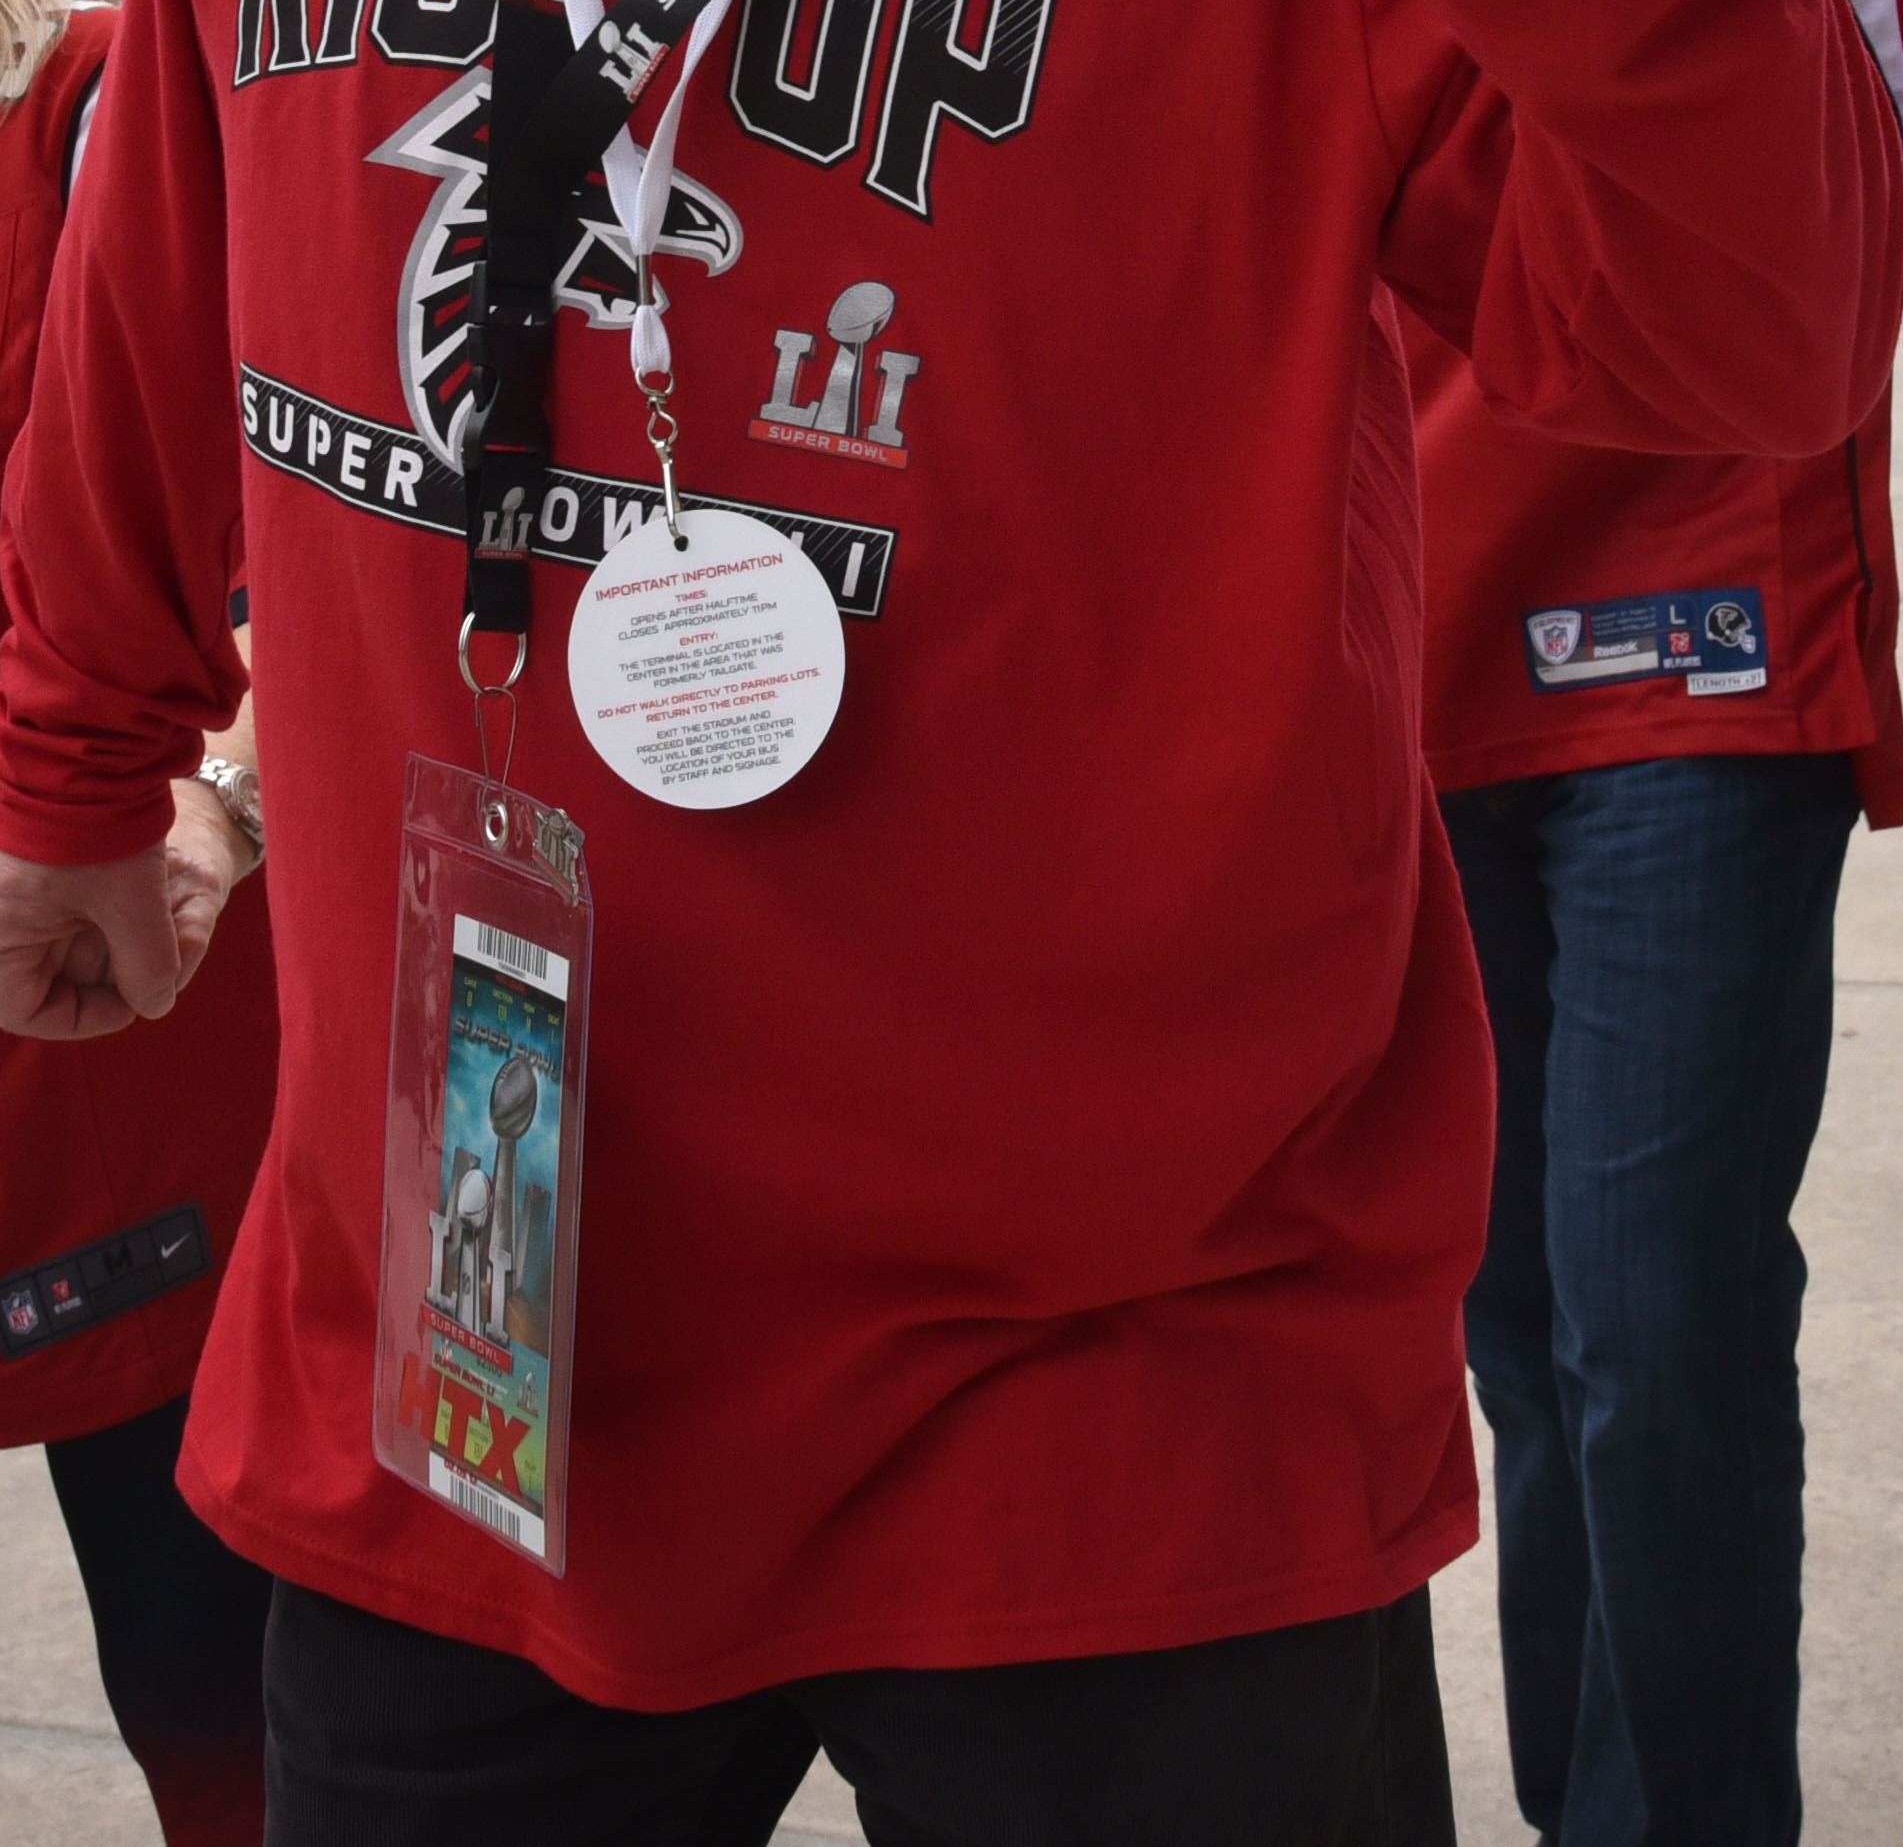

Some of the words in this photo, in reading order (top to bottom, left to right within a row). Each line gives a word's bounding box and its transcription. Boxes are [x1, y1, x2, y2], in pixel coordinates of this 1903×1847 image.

[759, 328, 922, 447] LI
[239, 379, 425, 509] SUPER
[767, 425, 831, 452] SUPER
[837, 439, 888, 463] BOWL
[596, 573, 679, 601] IMPORTANT
[683, 553, 783, 584] INFORMATION
[631, 611, 667, 626] OPENS
[669, 603, 704, 619] AFTER
[706, 592, 758, 611] HALFTIME
[675, 590, 708, 602] TIMES:
[618, 625, 659, 640] CLOSES
[664, 607, 750, 632] APPROXIMATELY
[1669, 604, 1687, 626] L
[620, 660, 639, 672] THE
[642, 650, 691, 669] TERMINAL
[704, 639, 750, 657] LOCATED
[751, 636, 762, 647] IN
[764, 632, 784, 644] THE
[680, 632, 718, 647] ENTRY:
[1594, 641, 1639, 658] Reebok
[627, 668, 666, 682] CENTER
[669, 665, 679, 675] IN
[681, 660, 700, 672] THE
[703, 654, 731, 668] AREA
[733, 649, 758, 662] THAT
[761, 643, 783, 655] WAS
[654, 670, 706, 688] FORMERLY
[598, 709, 613, 719] DO
[616, 704, 637, 716] NOT
[639, 698, 669, 711] WALK
[672, 687, 722, 704] DIRECTLY
[724, 684, 739, 694] TO
[741, 674, 788, 691] PARKING
[791, 668, 821, 681] LOTS.
[646, 707, 690, 723] RETURN
[692, 704, 707, 714] TO
[710, 699, 731, 711] THE
[733, 691, 778, 707] CENTER.
[636, 738, 683, 755] PROCEED
[686, 734, 713, 746] BACK
[715, 731, 729, 740] TO
[731, 726, 751, 737] THE
[657, 728, 678, 739] EXIT
[681, 723, 701, 735] THE
[703, 717, 747, 731] STADIUM
[749, 710, 771, 722] AND
[641, 754, 663, 765] YOU
[665, 750, 688, 761] WILL
[690, 747, 703, 756] BE
[706, 737, 755, 753] DIRECTED
[758, 733, 772, 743] TO
[775, 729, 794, 740] THE
[660, 758, 709, 774] LOCATION
[711, 753, 724, 764] OF
[727, 748, 756, 762] YOUR
[758, 744, 779, 755] BUS
[662, 776, 676, 785] BY
[678, 769, 709, 783] STAFF
[712, 764, 733, 776] AND
[453, 1014, 511, 1054] SUPER
[9, 1305, 34, 1330] NFL
[430, 1312, 465, 1341] SUPER
[469, 1335, 500, 1363] BOWL
[397, 1350, 531, 1497] HTX
